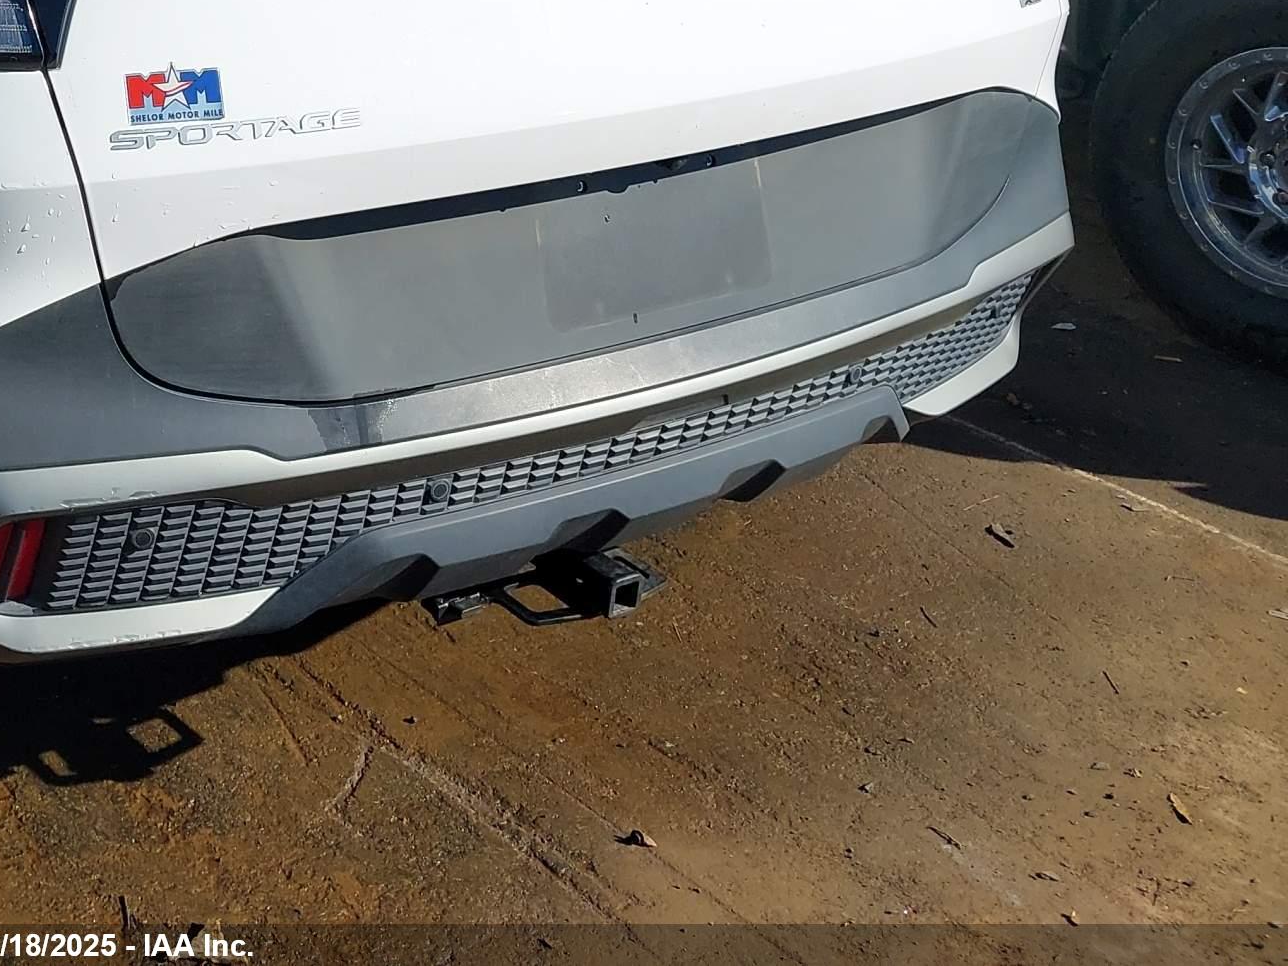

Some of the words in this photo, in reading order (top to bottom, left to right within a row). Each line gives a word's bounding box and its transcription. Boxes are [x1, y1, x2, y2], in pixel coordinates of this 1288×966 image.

[109, 107, 361, 152] SPORTAGE
[130, 111, 164, 123] SHELOR
[167, 109, 200, 121] MOTOR
[203, 107, 224, 119] MILE
